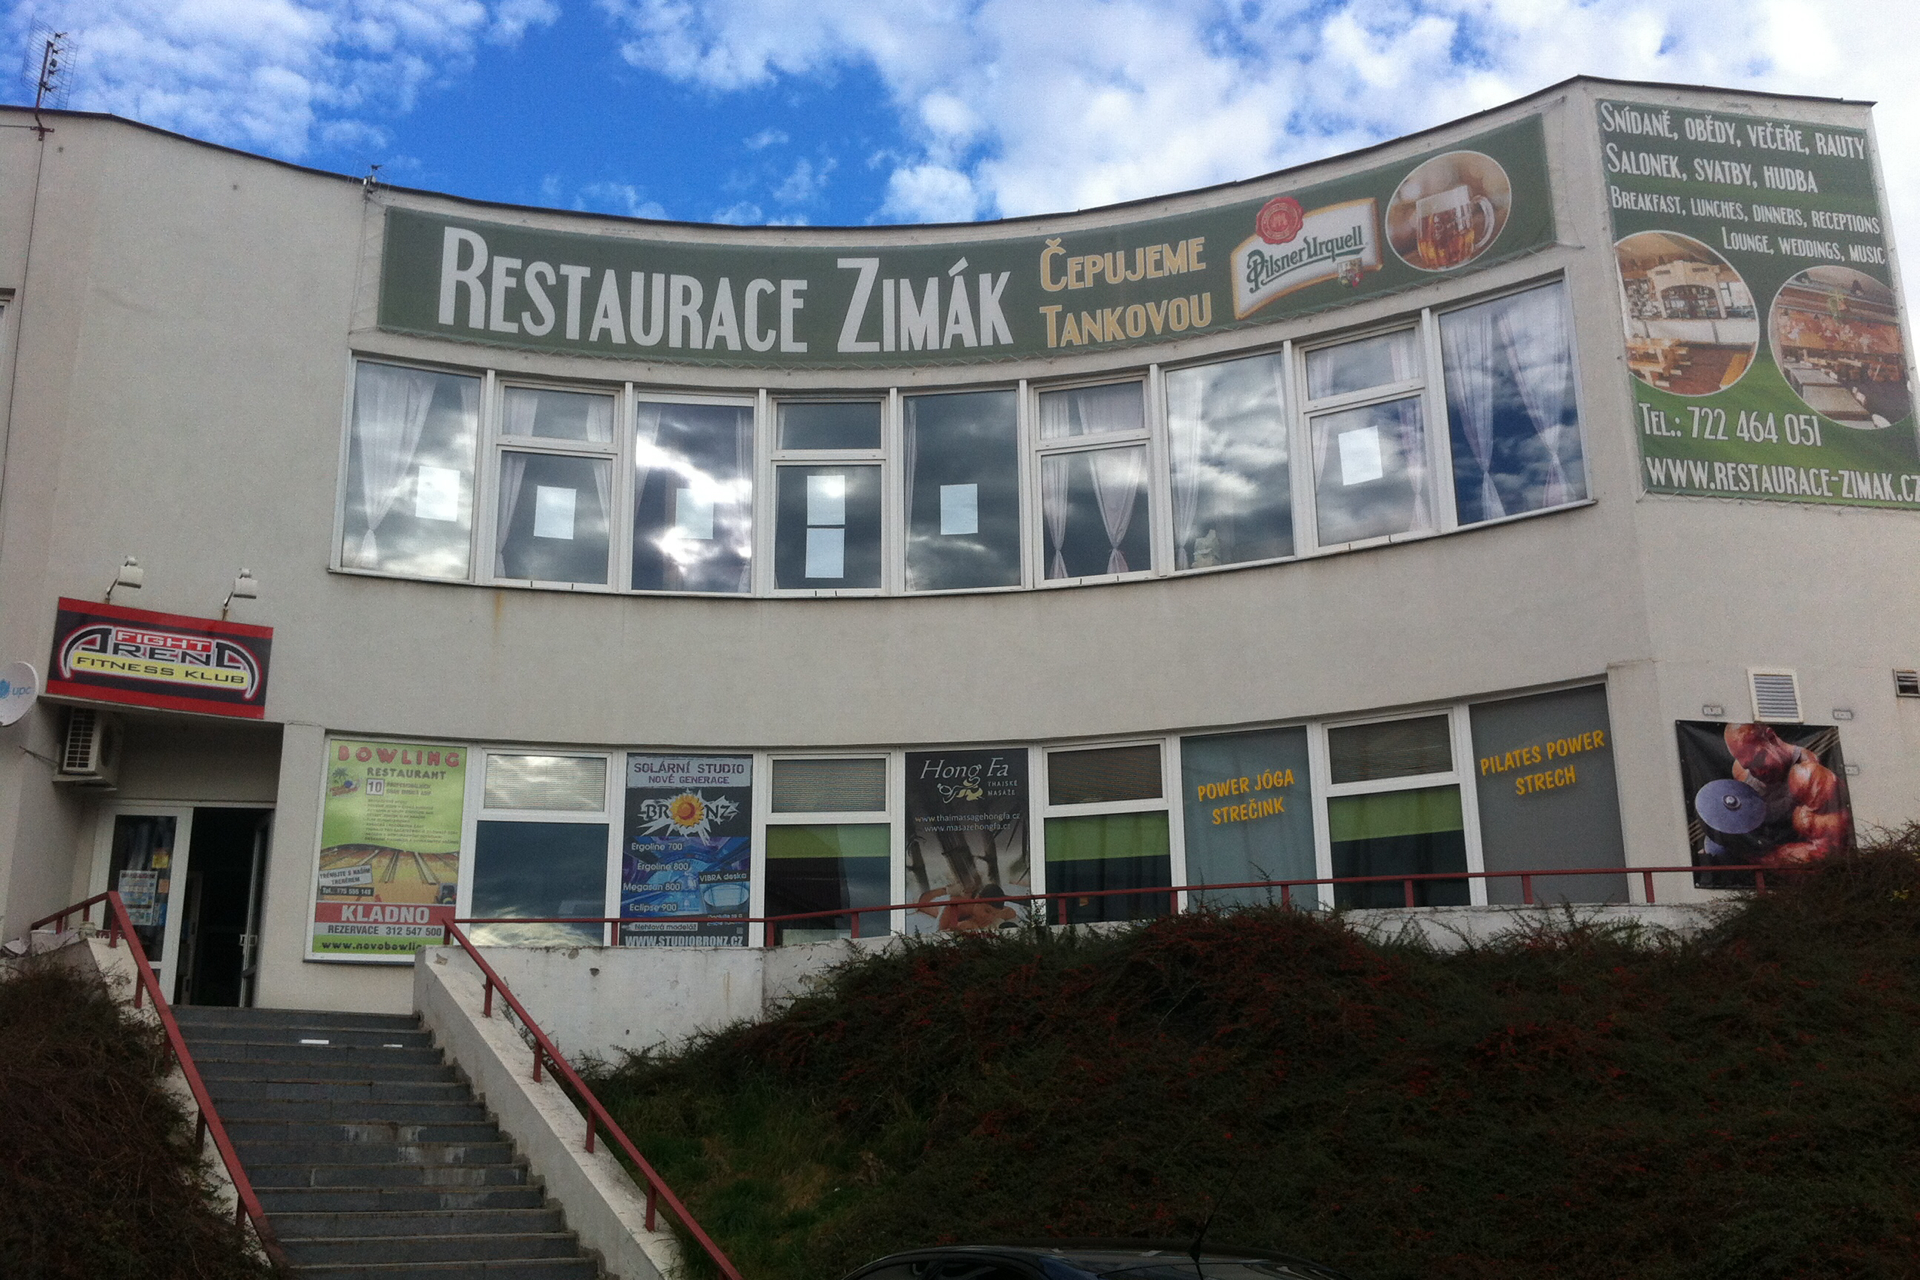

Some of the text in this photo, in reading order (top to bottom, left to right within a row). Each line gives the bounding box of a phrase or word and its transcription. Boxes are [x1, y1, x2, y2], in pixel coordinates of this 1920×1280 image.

[1685, 115, 1741, 147] OBĚDY,
[1747, 122, 1810, 155] VEČEŘE,
[1815, 133, 1864, 160] RAUTY
[1694, 158, 1757, 189] SVATBY,
[1763, 165, 1818, 194] HUDBA
[1691, 198, 1748, 222] LUNCHES,
[1753, 204, 1807, 228] DINNERS,
[1811, 210, 1880, 234] RECEPTIONS
[1246, 225, 1363, 294] Pilsner Urquell
[1778, 236, 1845, 262] WEDDINGS,
[1849, 244, 1885, 265] MUSIC
[1687, 406, 1728, 440] 722
[1736, 410, 1778, 444] 464
[1784, 414, 1822, 447] 051
[1645, 457, 1920, 503] WWW.RESTAURACE-ZIMAK.CZ
[116, 630, 211, 651] FIGHT
[61, 626, 258, 698] ARENA
[77, 656, 245, 684] FITNESS KLUB
[12, 686, 31, 698] upc
[338, 745, 460, 767] BOWLING
[1481, 729, 1605, 776] PILATES POWER
[366, 767, 446, 780] RESTAURANT
[634, 761, 745, 774] SOLÁRNÍ STUDIO
[920, 757, 1009, 785] Hong Fa
[368, 781, 383, 793] 10
[648, 774, 729, 784] NOVÉ GENERACE
[1197, 768, 1295, 802] POWER JÓGA
[1516, 764, 1577, 795] STRECH
[1212, 796, 1285, 825] STREČINK
[631, 842, 665, 852] Ergoline
[637, 862, 671, 871] Ergoline
[699, 872, 747, 882] VIBRA deska
[665, 883, 680, 891] 800
[341, 904, 430, 924] KLADNO
[629, 903, 677, 912] Eclipse 900
[328, 924, 442, 937] REZERVACE 312 547 500
[625, 935, 744, 947] WWW.STUDIOBRONZ.CZ
